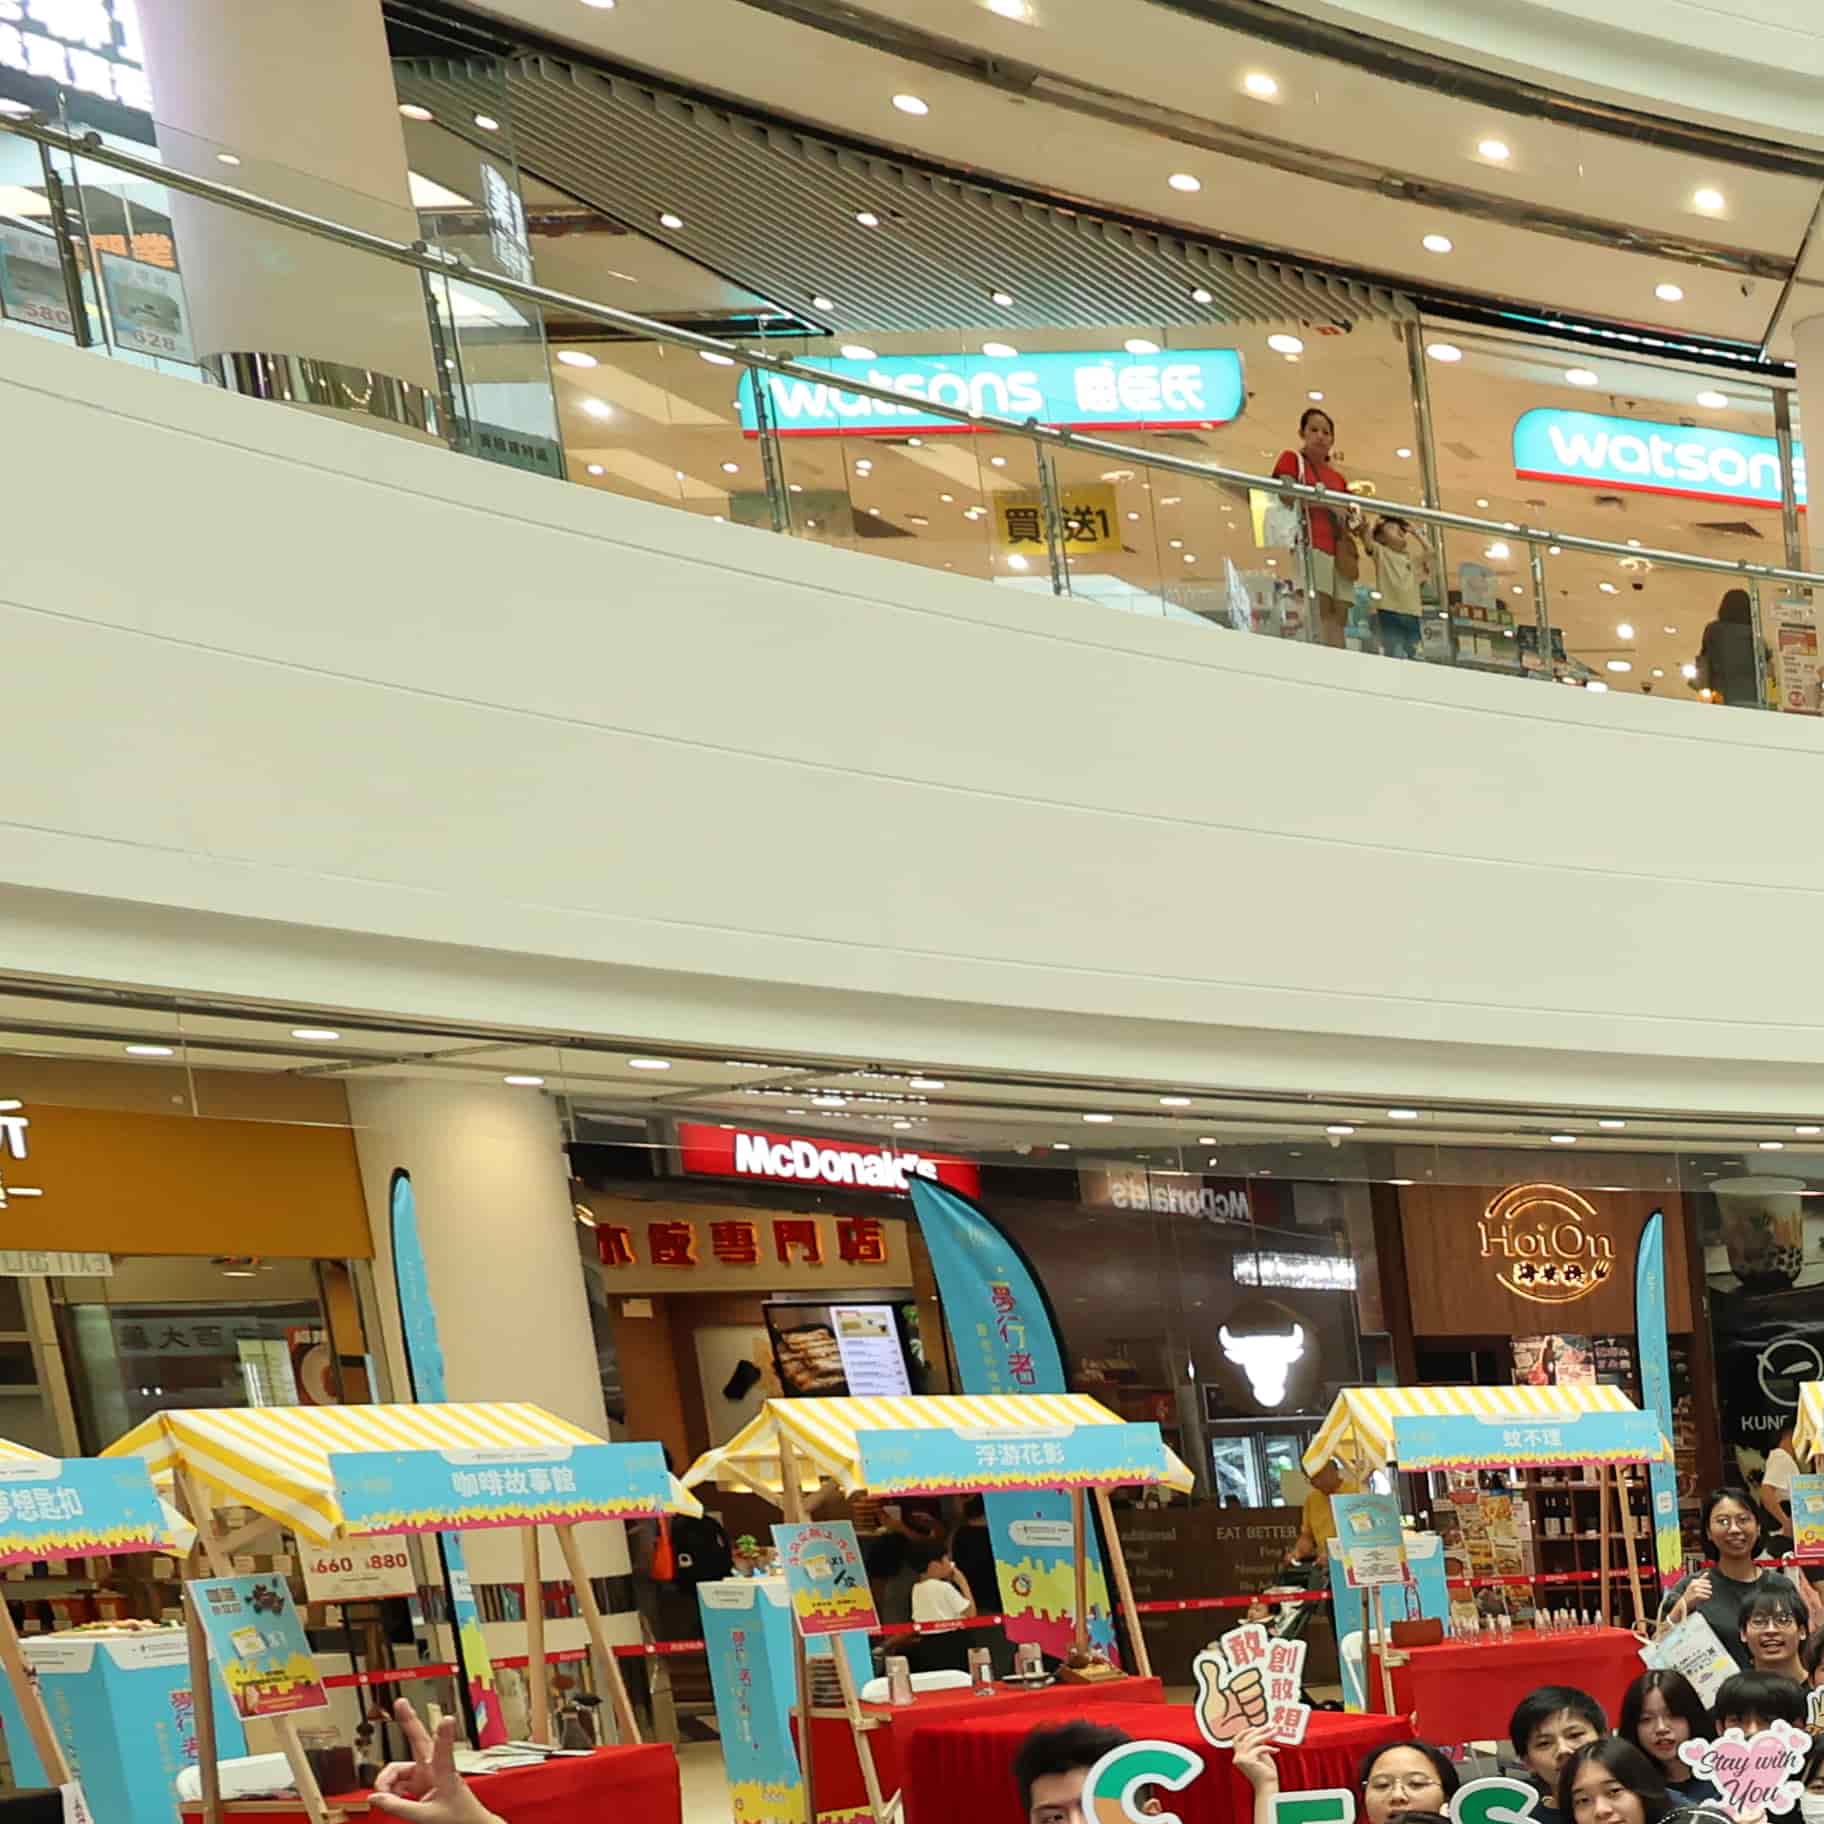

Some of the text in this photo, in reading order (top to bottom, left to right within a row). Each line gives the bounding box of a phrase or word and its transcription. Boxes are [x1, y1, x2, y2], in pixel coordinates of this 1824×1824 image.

[768, 365, 1044, 419] watsons
[1005, 506, 1109, 544] 買送1
[1478, 1220, 1616, 1258] HoiOn
[976, 1441, 1064, 1466] 浮游花影
[451, 1467, 576, 1496] 咖啡故事館
[1216, 1525, 1240, 1540] EAT
[1699, 1748, 1798, 1777] Stay with
[1722, 1779, 1778, 1814] You
